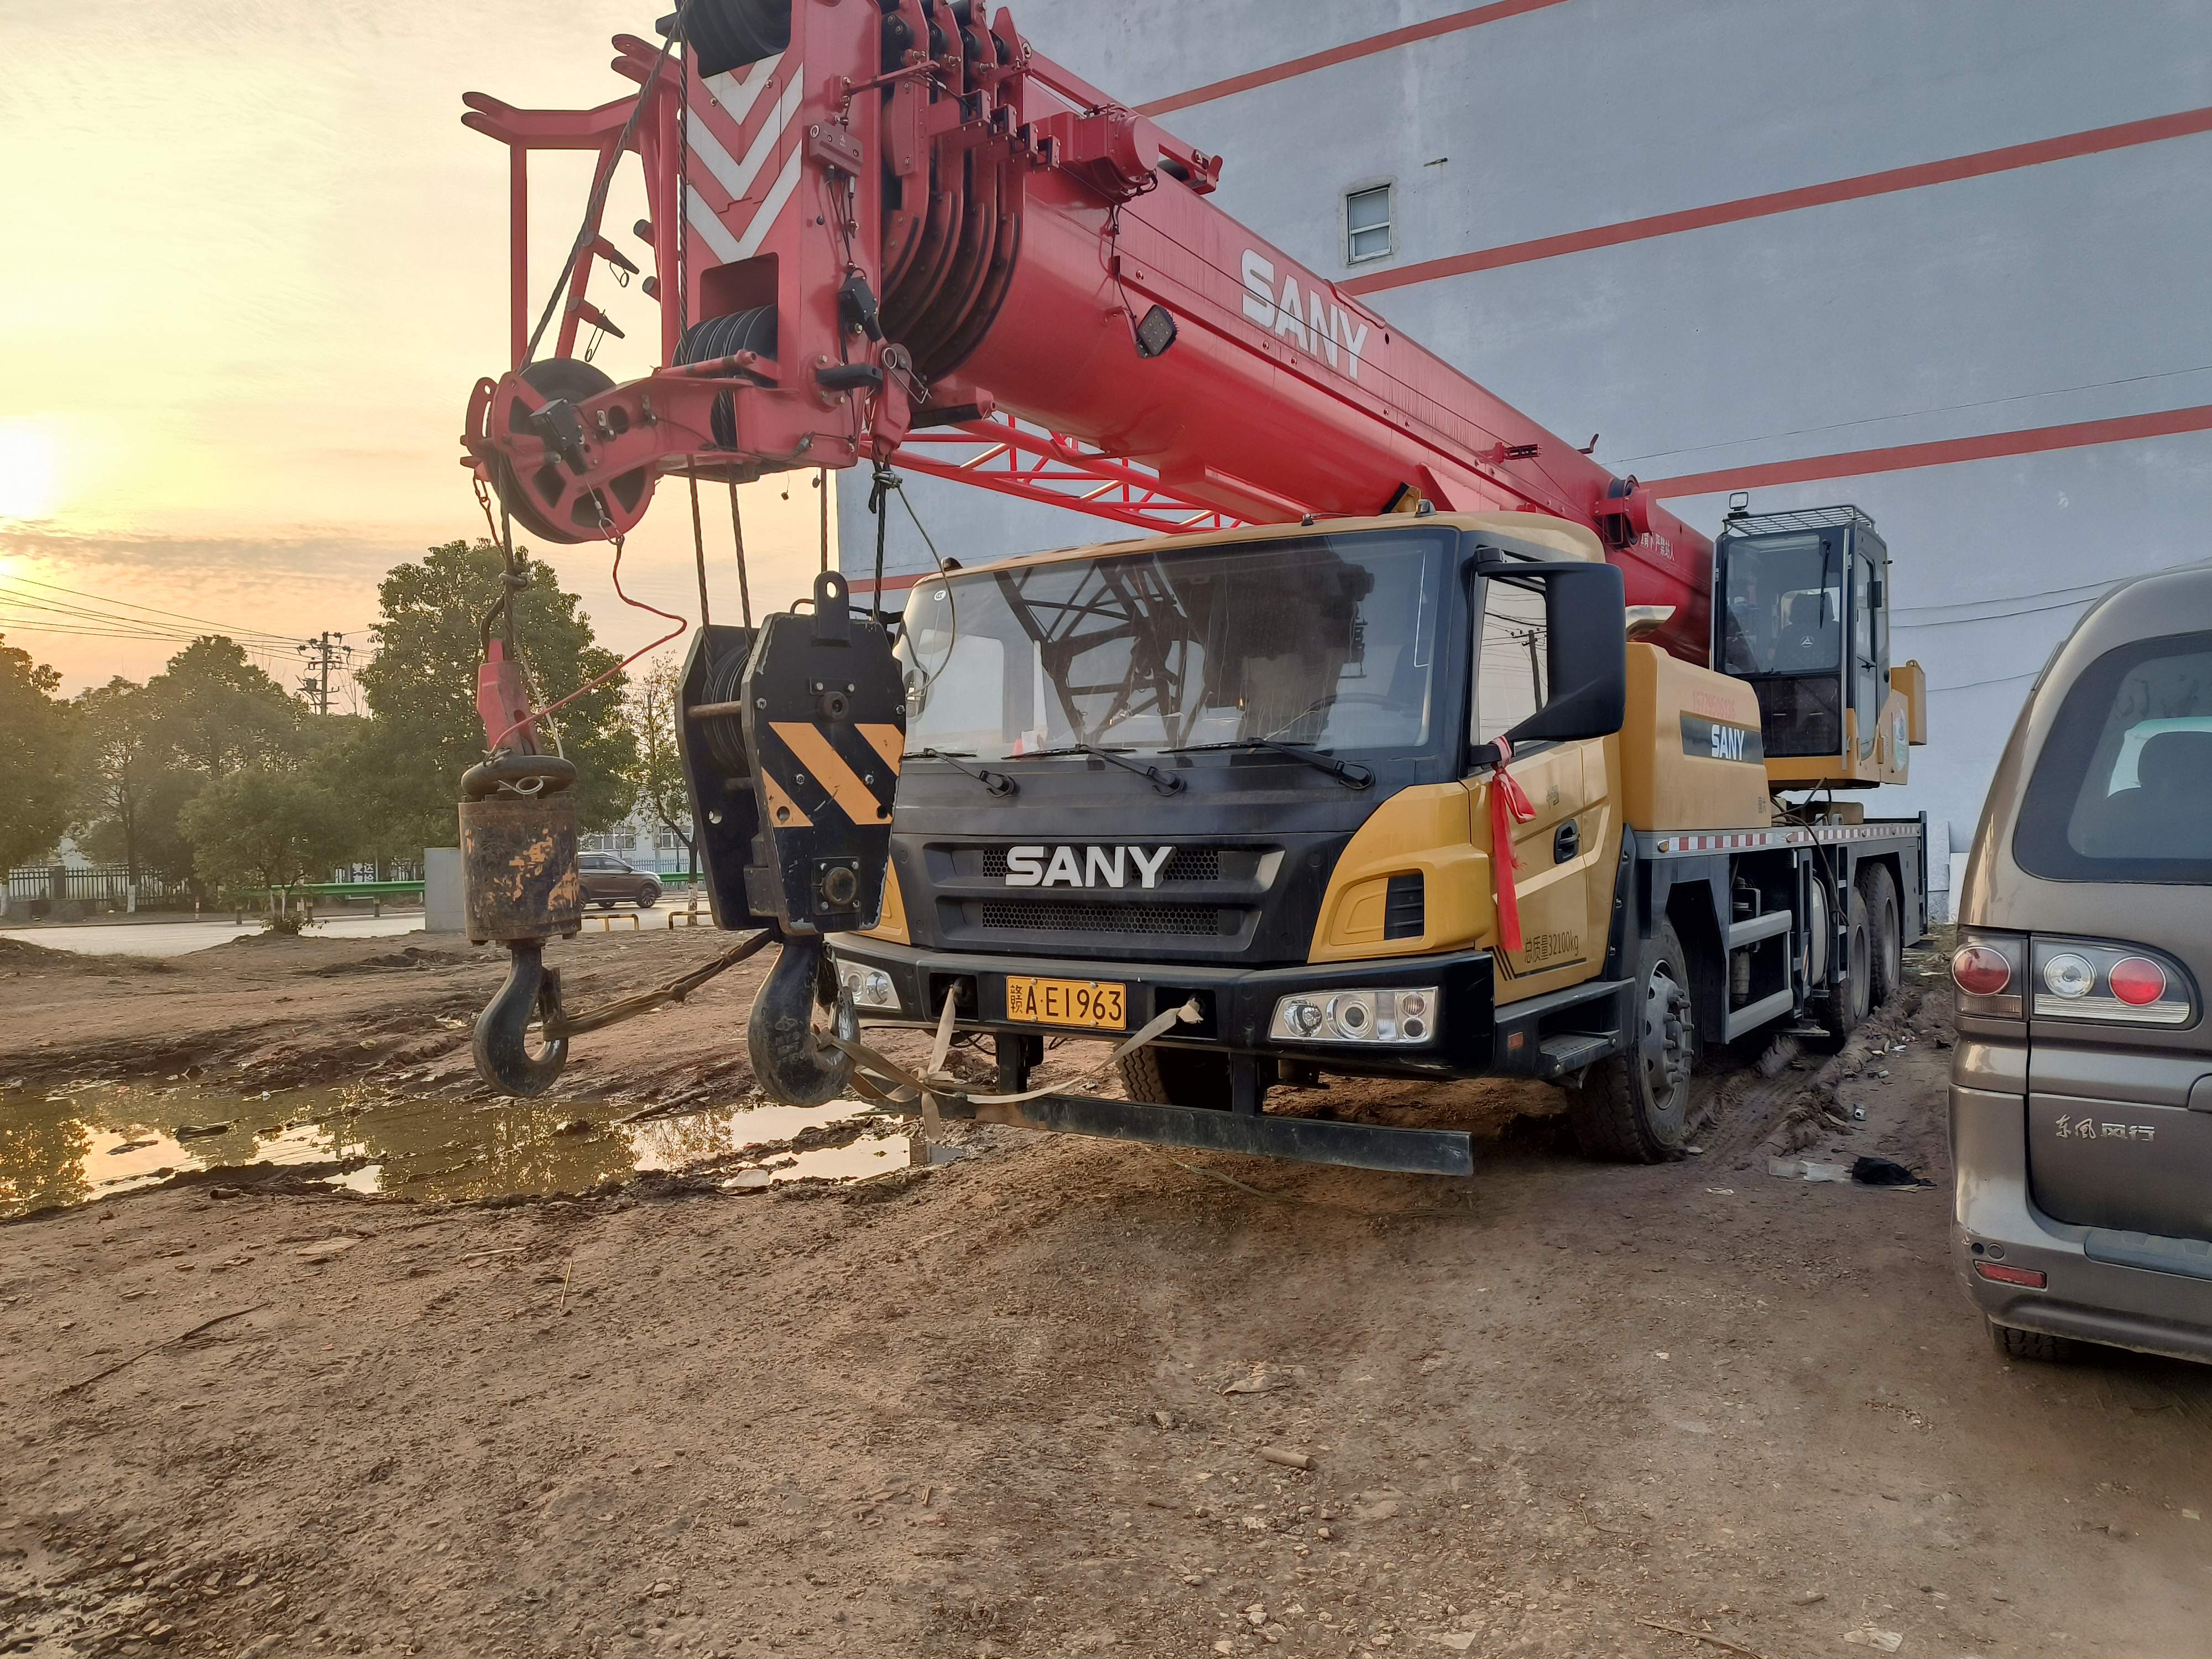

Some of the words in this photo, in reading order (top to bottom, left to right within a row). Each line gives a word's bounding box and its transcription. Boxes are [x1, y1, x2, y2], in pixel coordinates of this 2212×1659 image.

[1241, 248, 1369, 380] SANY
[1712, 724, 1745, 761] SANY
[1005, 846, 1174, 888] SANY
[1525, 930, 1579, 963] 总质量32100kg
